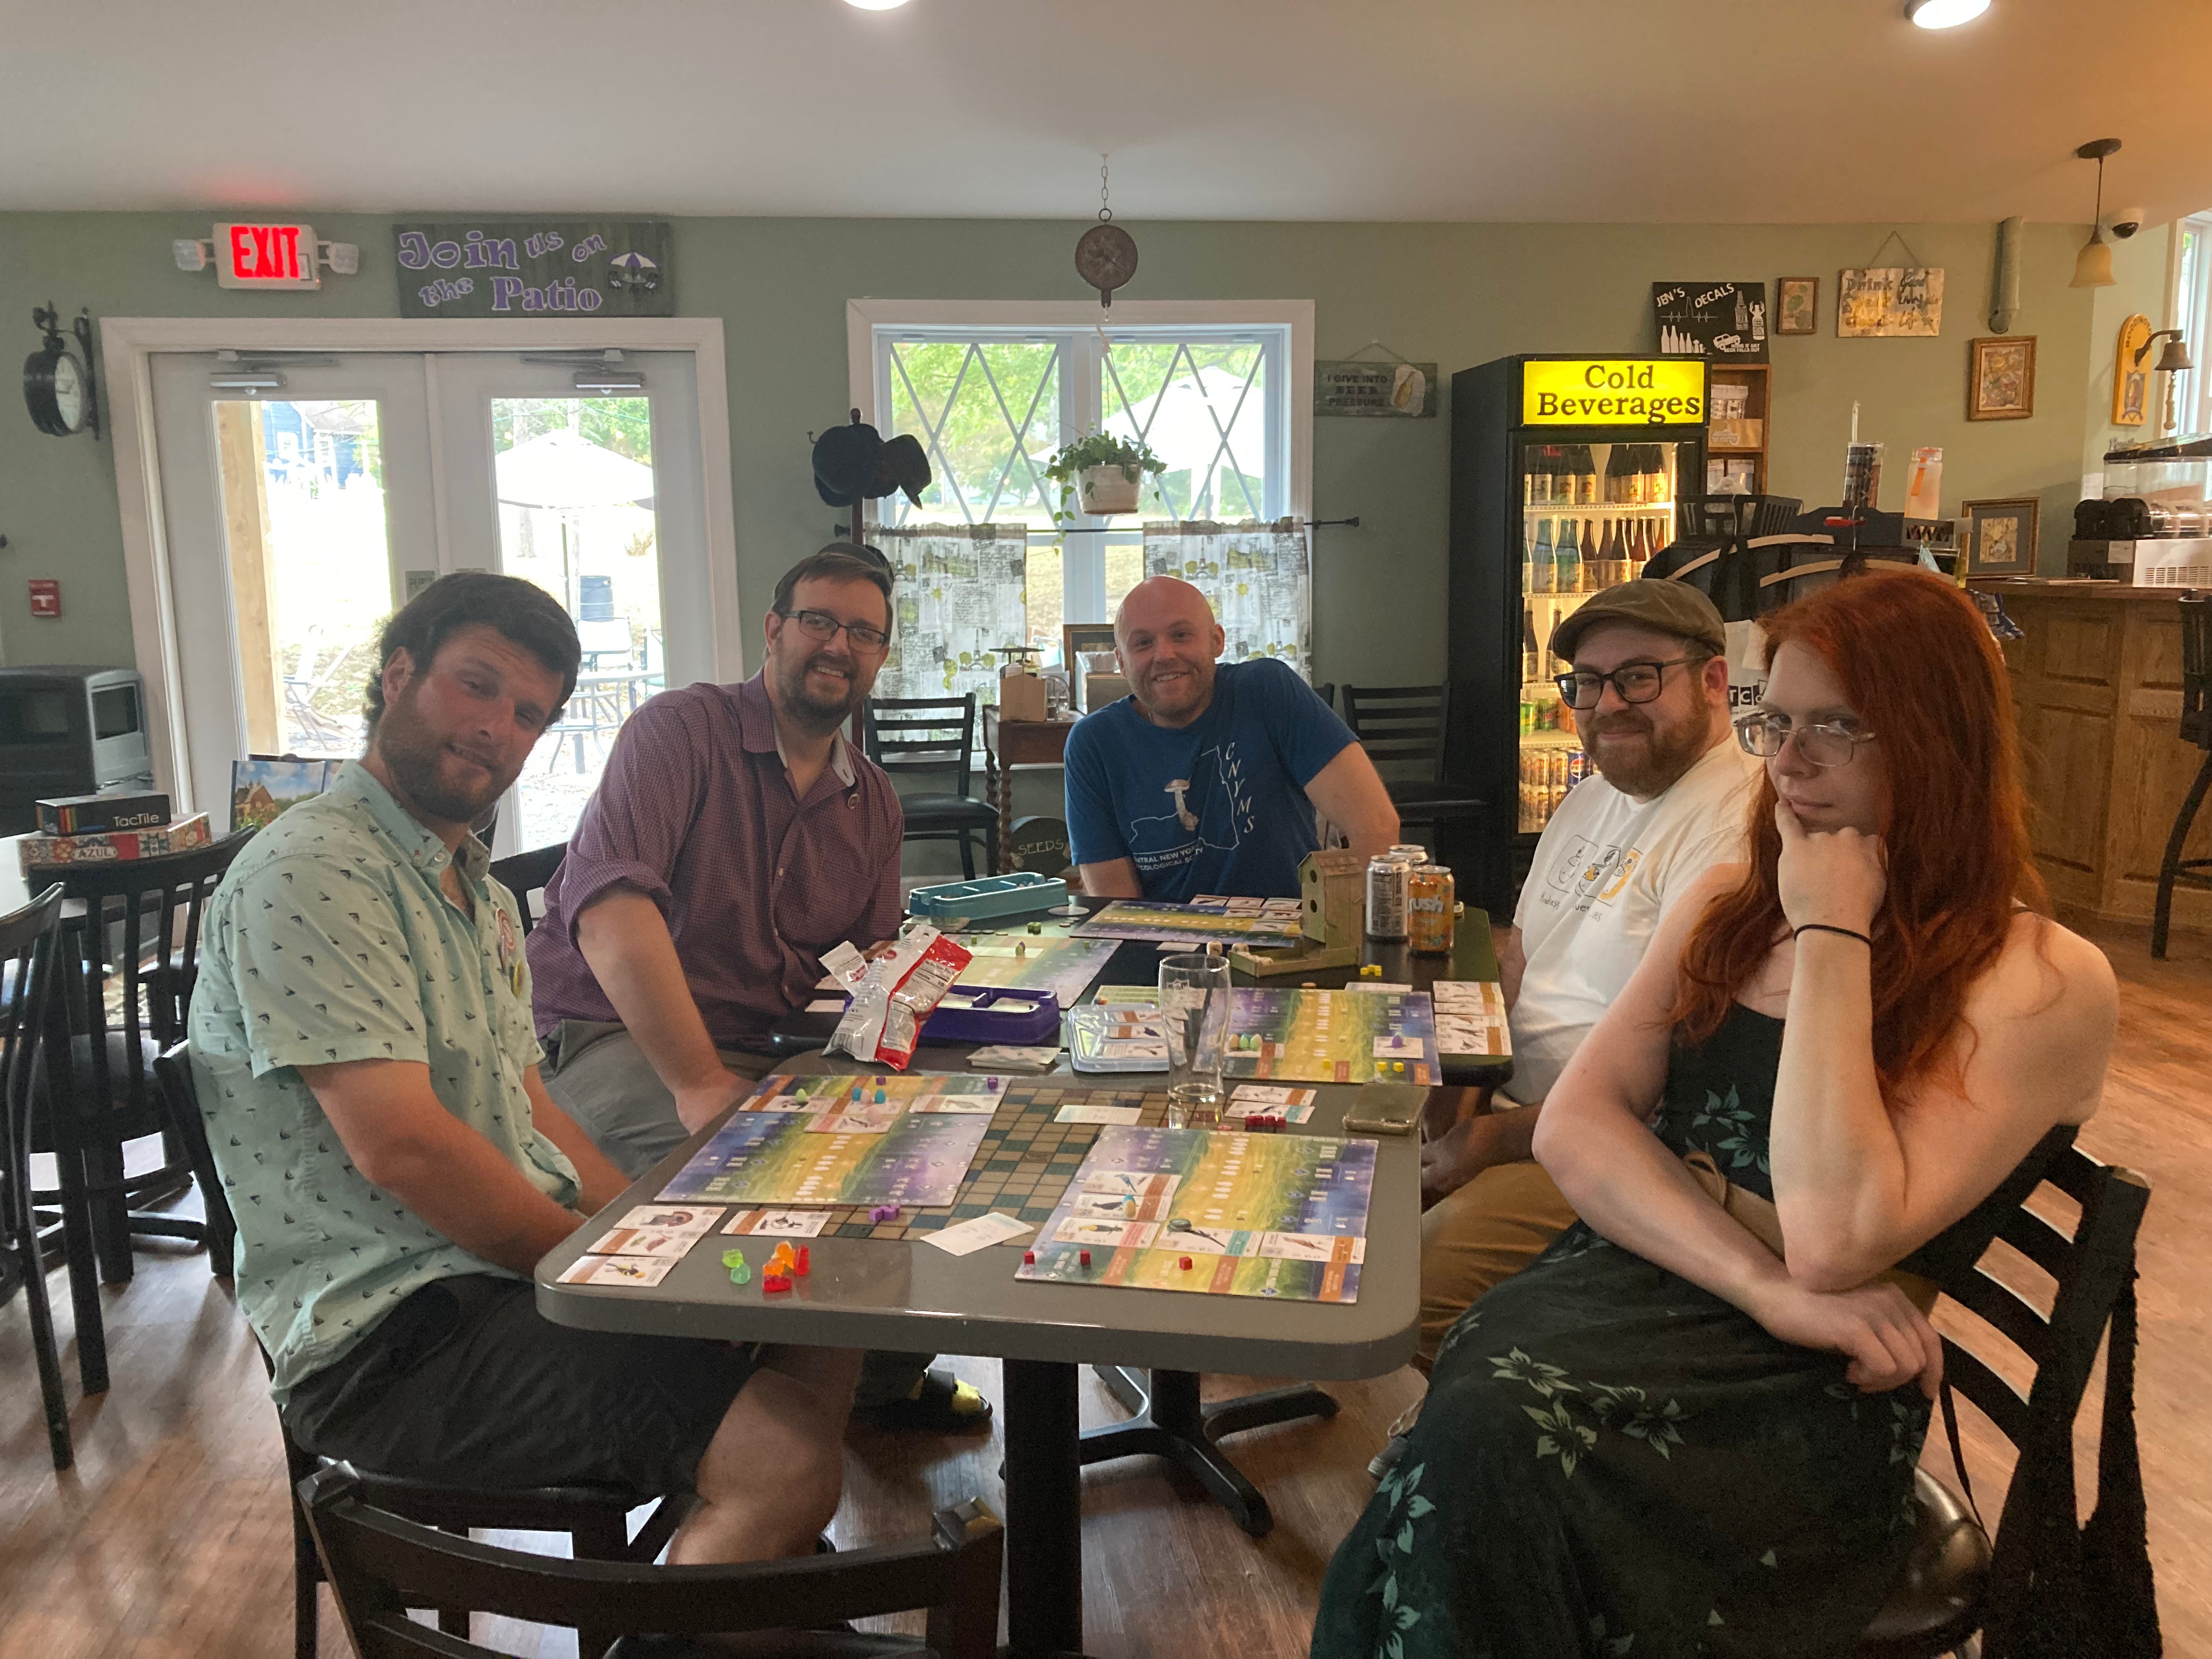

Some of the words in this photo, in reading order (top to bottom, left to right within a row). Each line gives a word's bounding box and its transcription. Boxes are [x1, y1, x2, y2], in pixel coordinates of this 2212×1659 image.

[230, 226, 300, 279] EXIT
[398, 230, 520, 269] Join
[524, 232, 564, 258] us
[572, 234, 607, 262] on
[418, 277, 474, 307] the
[489, 276, 602, 311] Patio
[1334, 375, 1359, 383] GIVE
[1363, 375, 1387, 383] INTO
[1585, 364, 1654, 389] Cold
[1335, 386, 1379, 394] BEER
[1329, 398, 1386, 407] PRESSURE
[1537, 392, 1700, 424] Beverages
[113, 812, 159, 827] TacTile
[78, 848, 111, 858] AZUL
[1018, 839, 1064, 856] SEEDS
[1160, 852, 1178, 861] NEW
